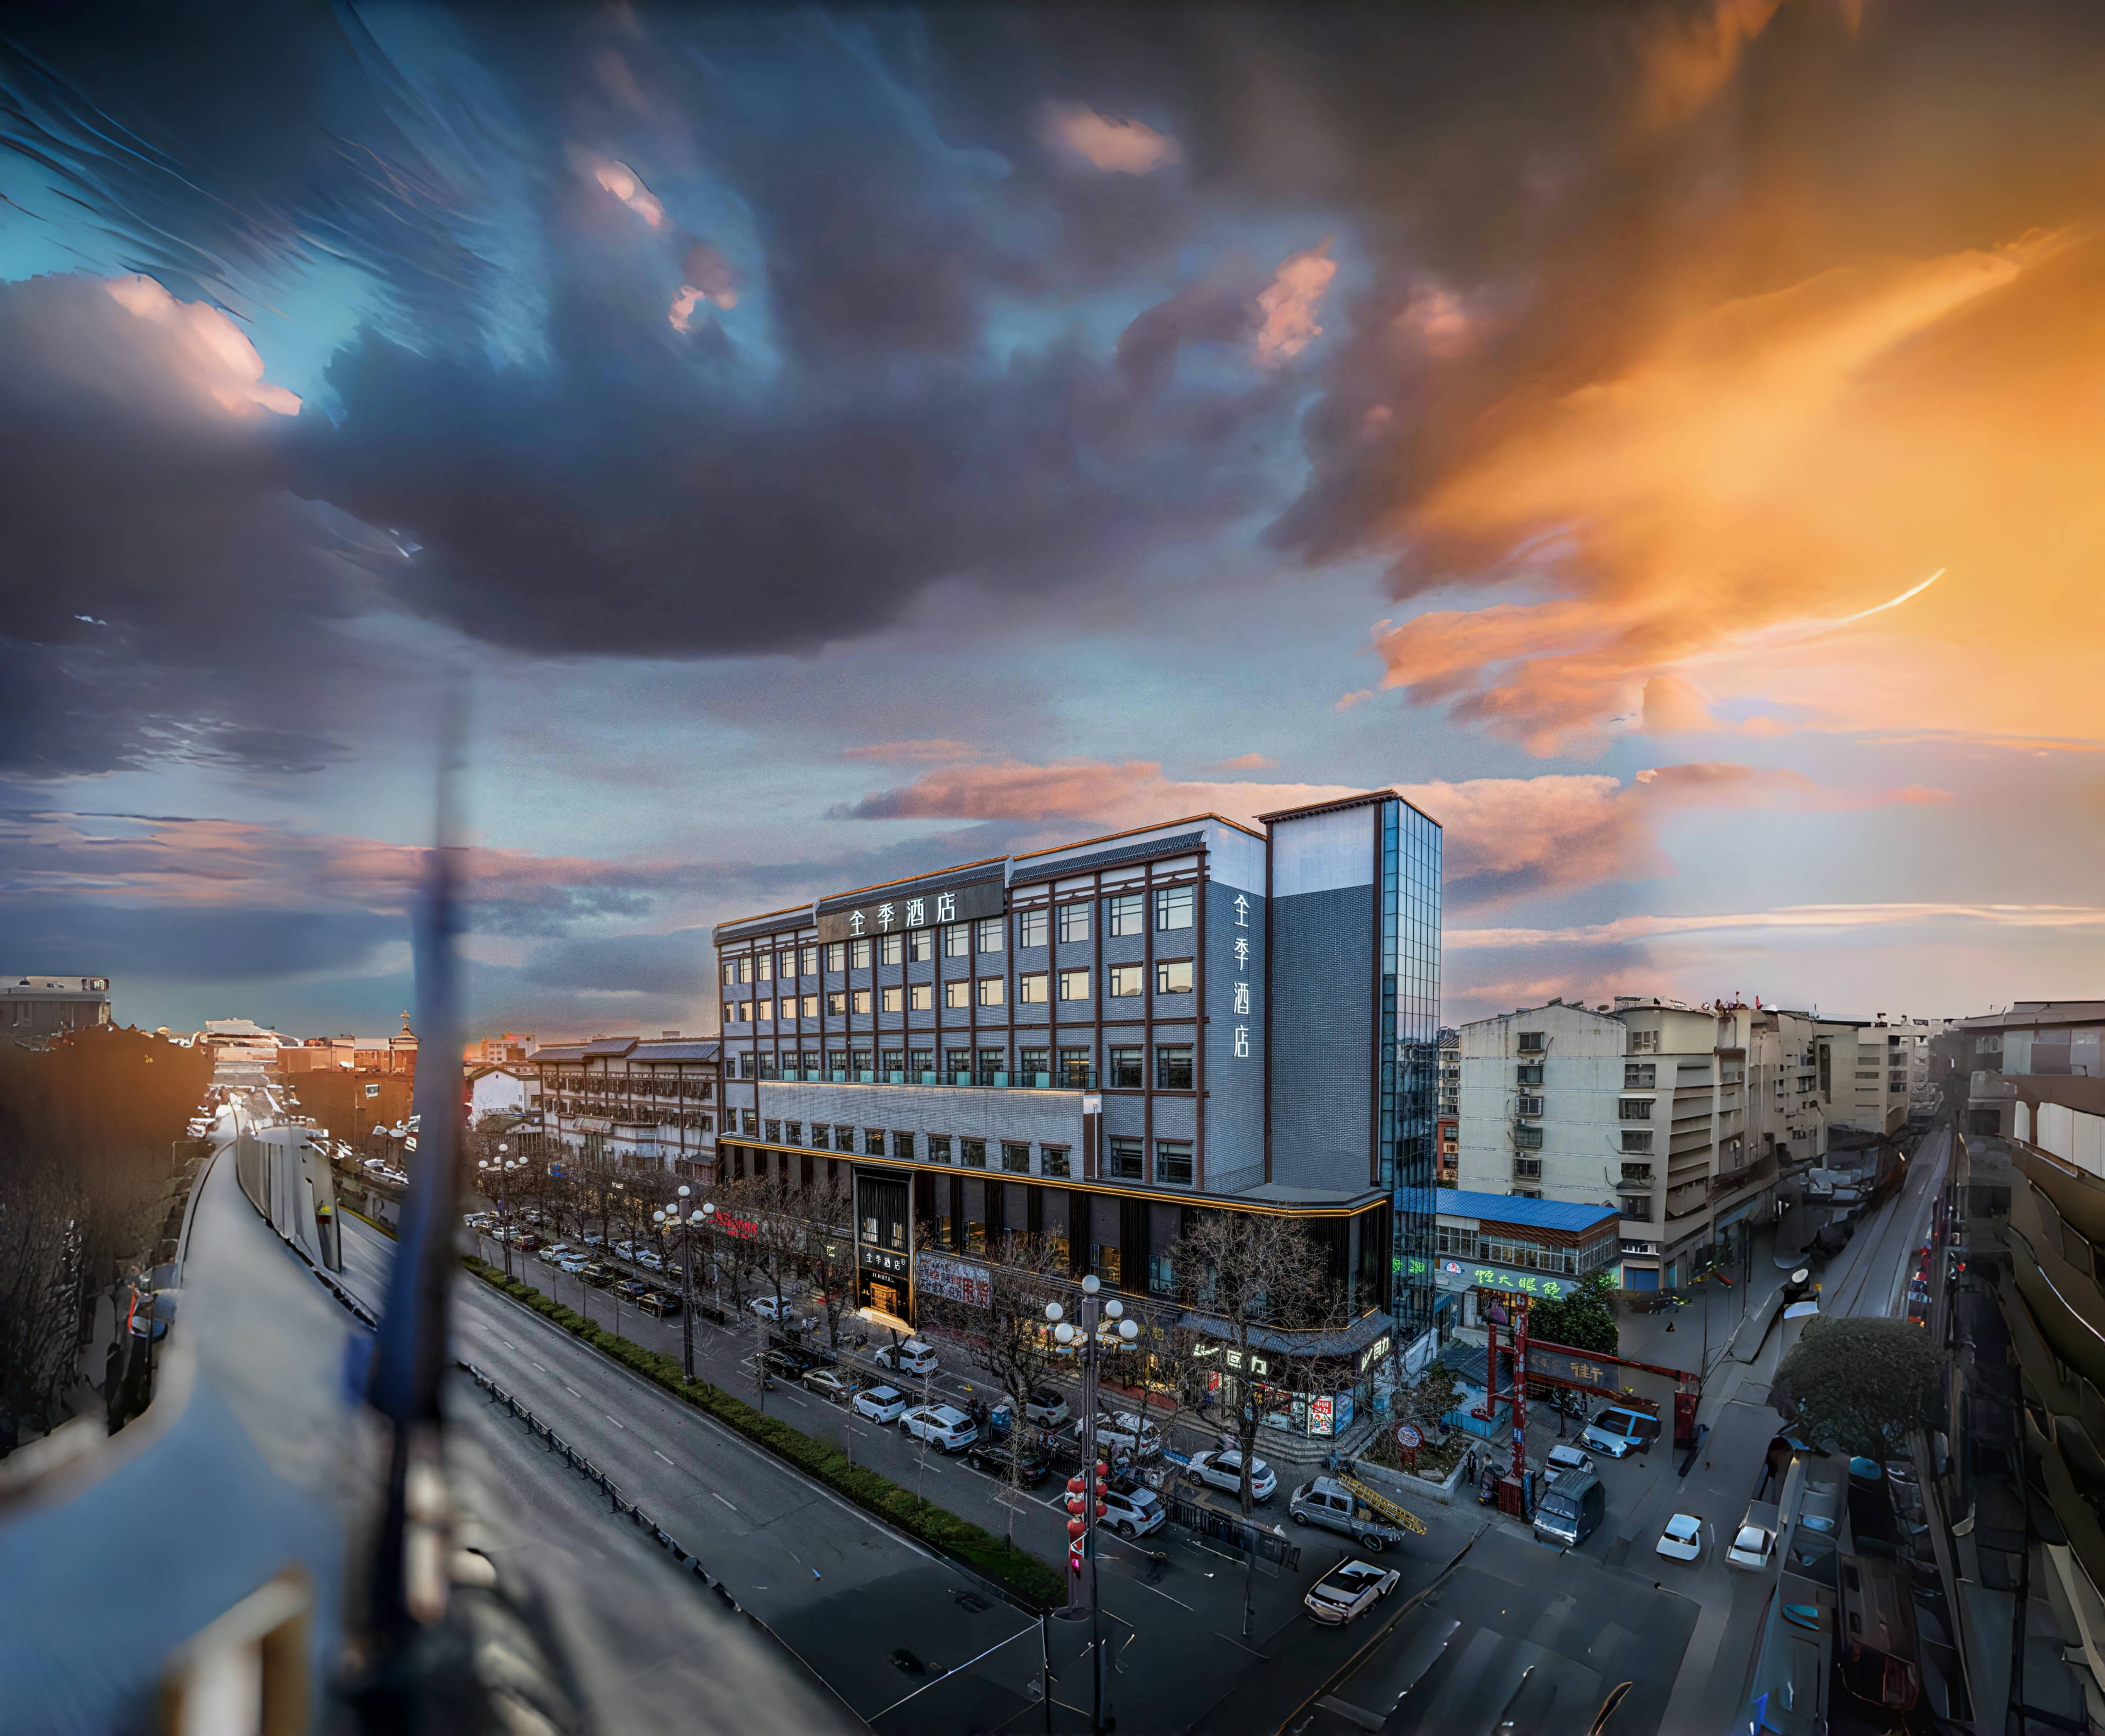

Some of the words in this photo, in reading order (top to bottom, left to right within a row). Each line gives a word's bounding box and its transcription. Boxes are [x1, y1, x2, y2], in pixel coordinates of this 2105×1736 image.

[850, 892, 957, 937] 全季酒店
[1233, 894, 1250, 1058] 全季酒店
[866, 1252, 900, 1271] 全季酒店
[878, 1274, 894, 1283] HOTEL
[1374, 1337, 1389, 1361] 回力
[1227, 1350, 1267, 1375] 回力
